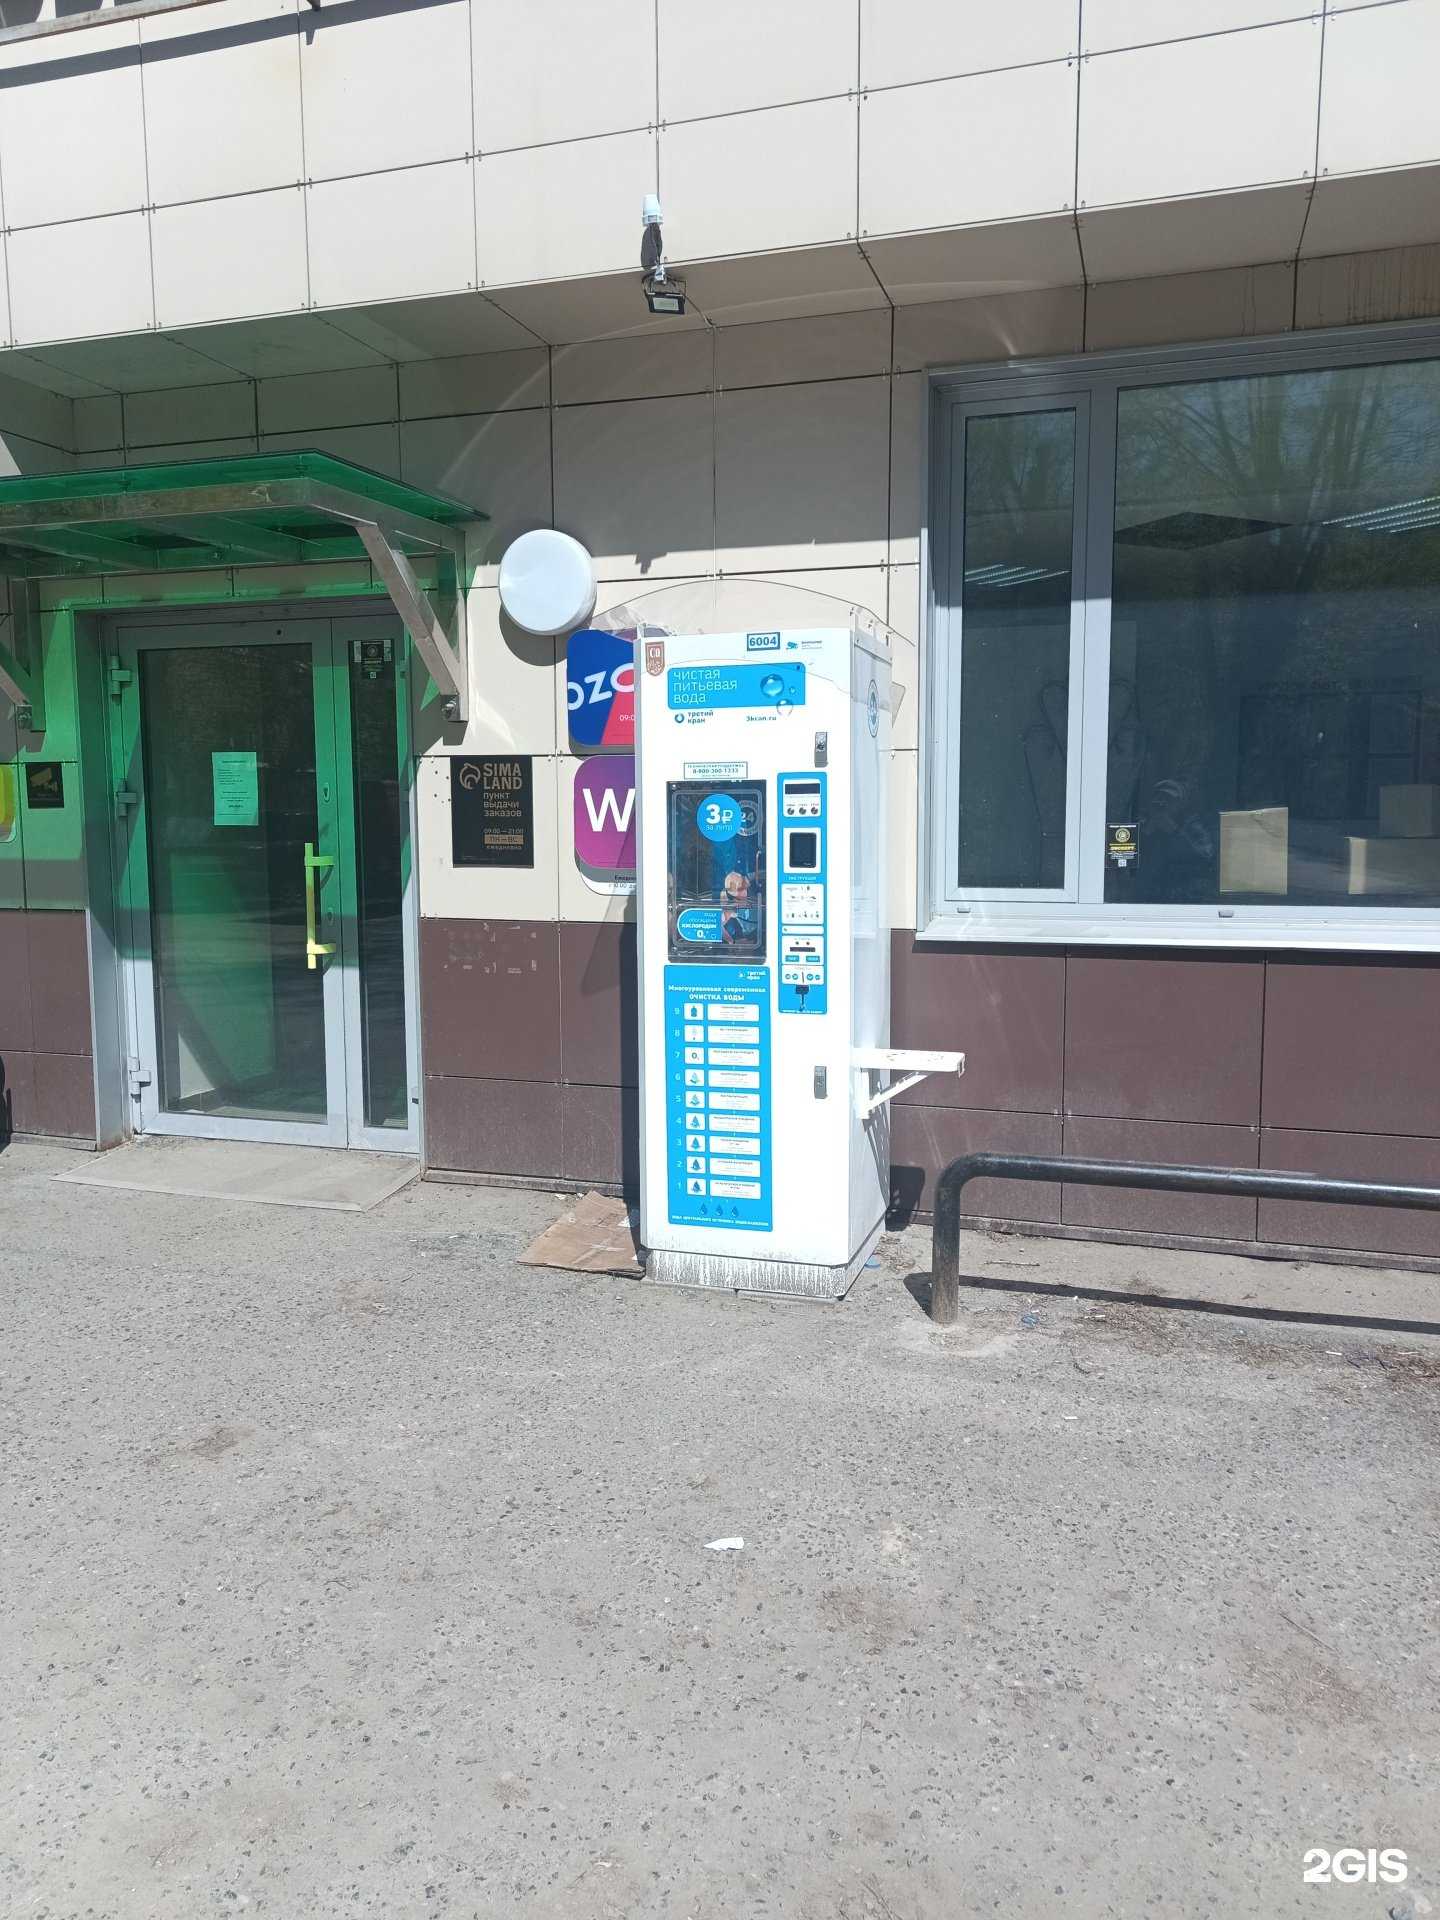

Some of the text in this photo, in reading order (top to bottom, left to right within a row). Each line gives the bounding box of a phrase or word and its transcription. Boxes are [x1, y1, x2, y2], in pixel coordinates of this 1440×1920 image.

[749, 636, 777, 647] 6004
[673, 669, 721, 681] чистая
[673, 679, 738, 693] питьевая
[673, 693, 706, 705] вода
[483, 763, 522, 777] SIMA
[483, 777, 522, 790] LAND
[483, 792, 511, 801] пункт
[483, 801, 520, 810] выдачи
[688, 993, 722, 1001] ОЧИСТКА
